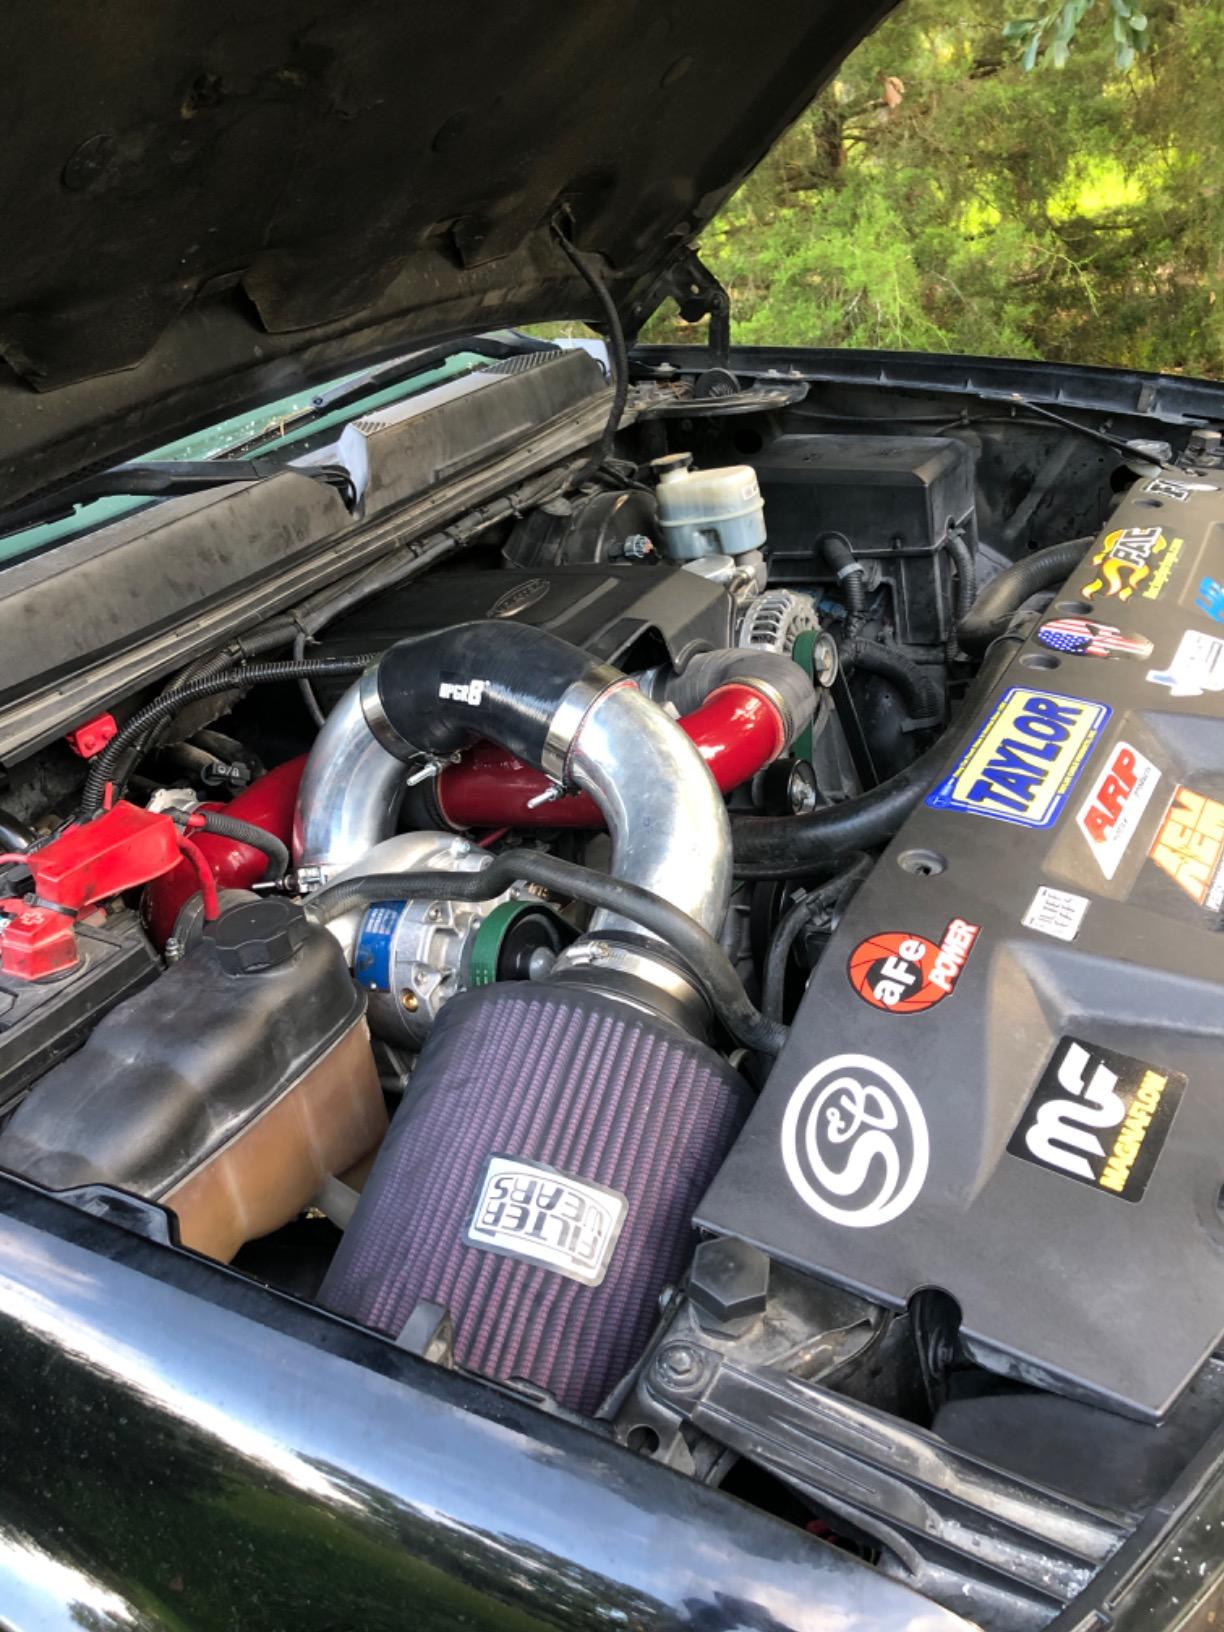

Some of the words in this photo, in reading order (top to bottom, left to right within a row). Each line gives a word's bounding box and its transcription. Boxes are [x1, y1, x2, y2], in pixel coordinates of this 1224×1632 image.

[966, 697, 1084, 812] TAYLOR
[1083, 748, 1137, 842] ARP
[873, 939, 926, 1005] aFe
[928, 918, 980, 991] POWER
[1100, 1069, 1169, 1192] MAGNAFLOW
[481, 1201, 598, 1260] FILTER
[489, 1177, 603, 1237] WEARS
